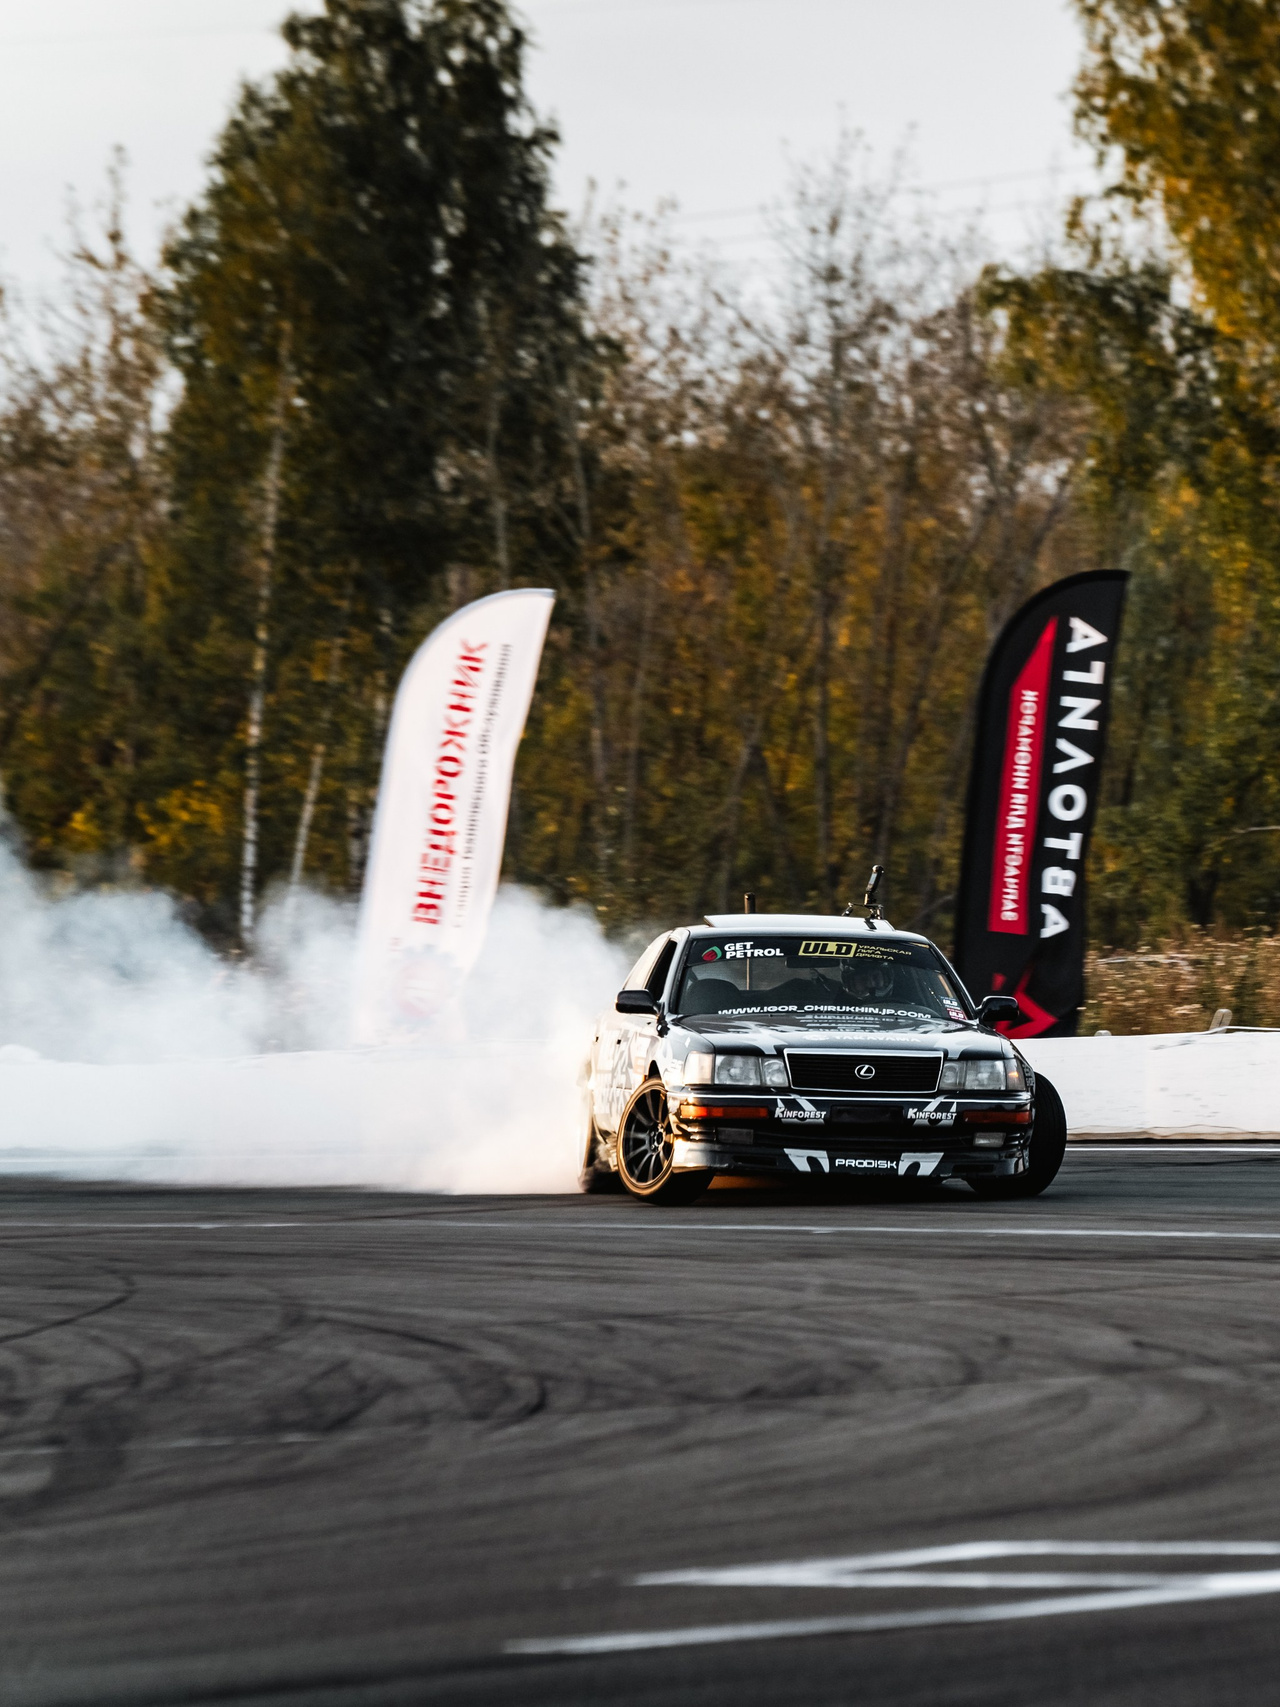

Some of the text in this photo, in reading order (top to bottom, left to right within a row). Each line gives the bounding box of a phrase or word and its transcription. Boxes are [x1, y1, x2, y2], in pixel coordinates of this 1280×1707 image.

[411, 638, 489, 926] ВНЕДОРОЖНИК
[724, 941, 754, 952] GET
[802, 942, 853, 956] ULD
[859, 944, 912, 955] УРАЛЬСКАЯ
[726, 948, 785, 959] PETROL
[855, 952, 894, 960] ДРИФТА
[907, 1108, 957, 1120] KINFOREST
[835, 1158, 897, 1169] PRODISK
